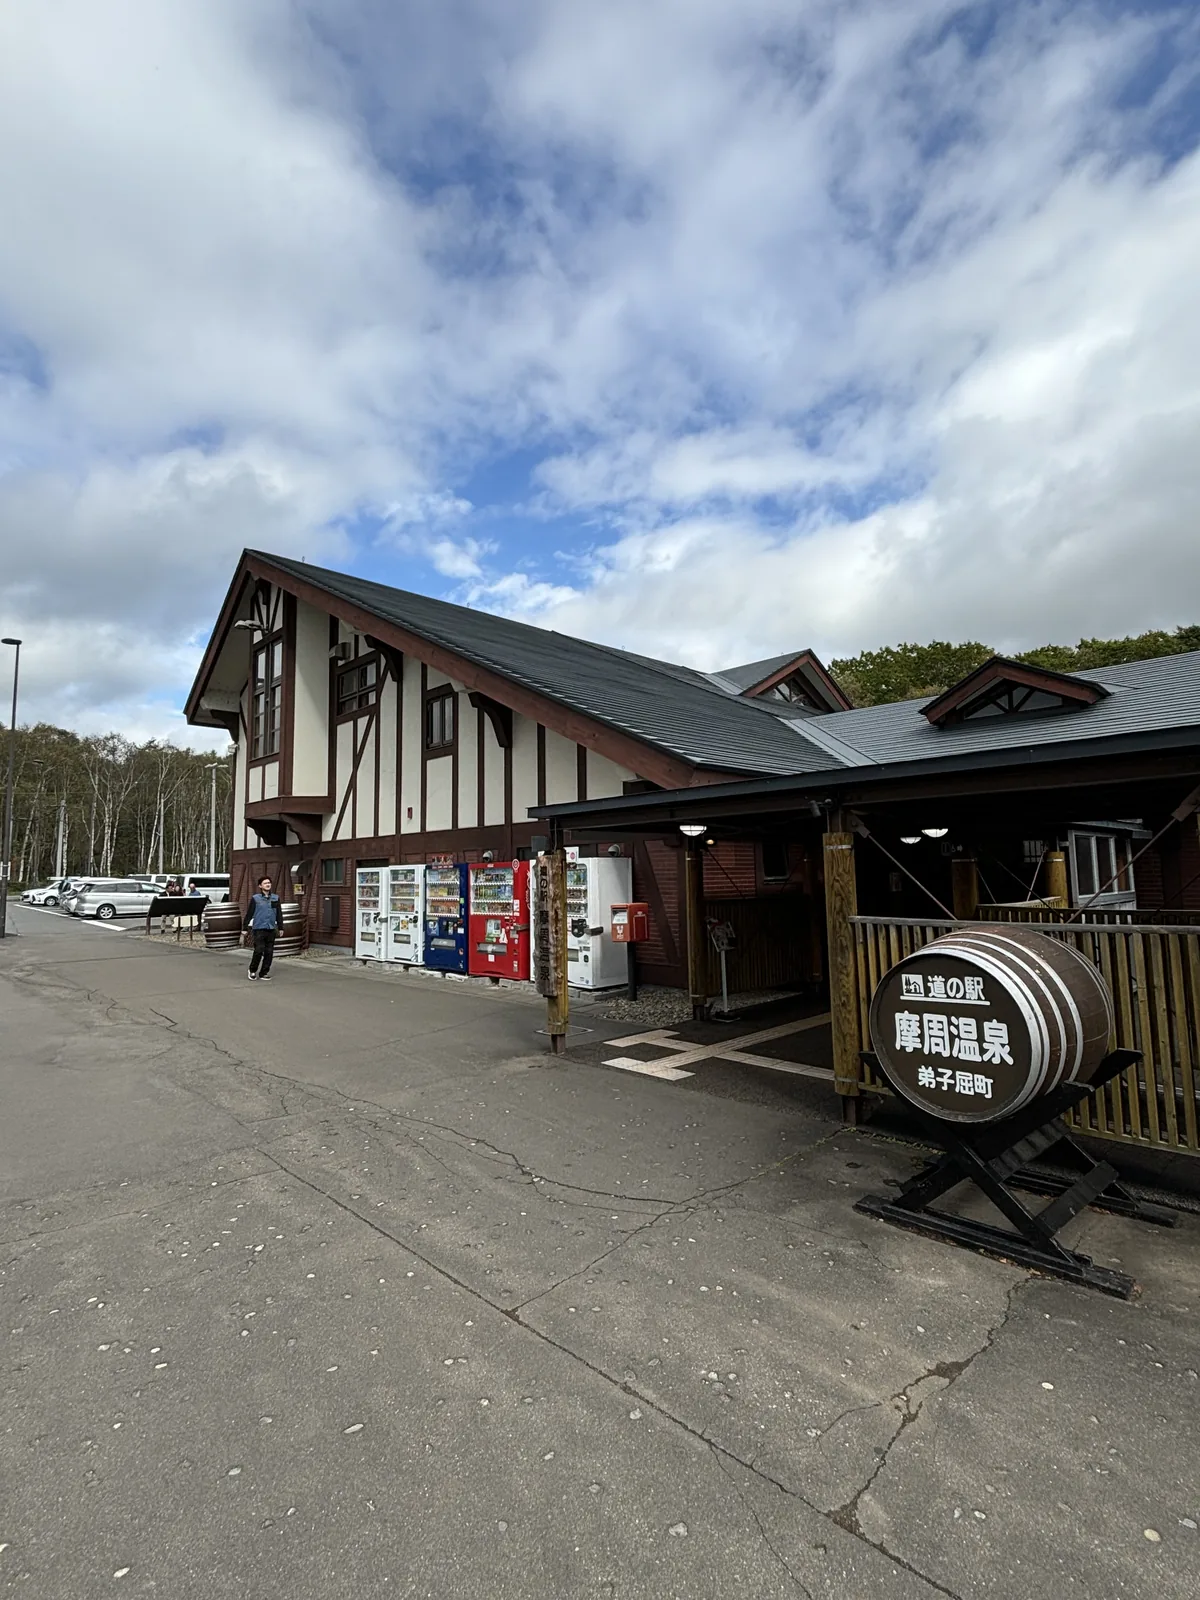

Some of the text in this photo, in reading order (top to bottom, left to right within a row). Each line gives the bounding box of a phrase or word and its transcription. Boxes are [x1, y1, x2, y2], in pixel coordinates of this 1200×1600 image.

[927, 975, 985, 1000] 道の駅
[894, 1010, 1014, 1065] 摩周温泉
[917, 1065, 994, 1099] 弟子屈町
